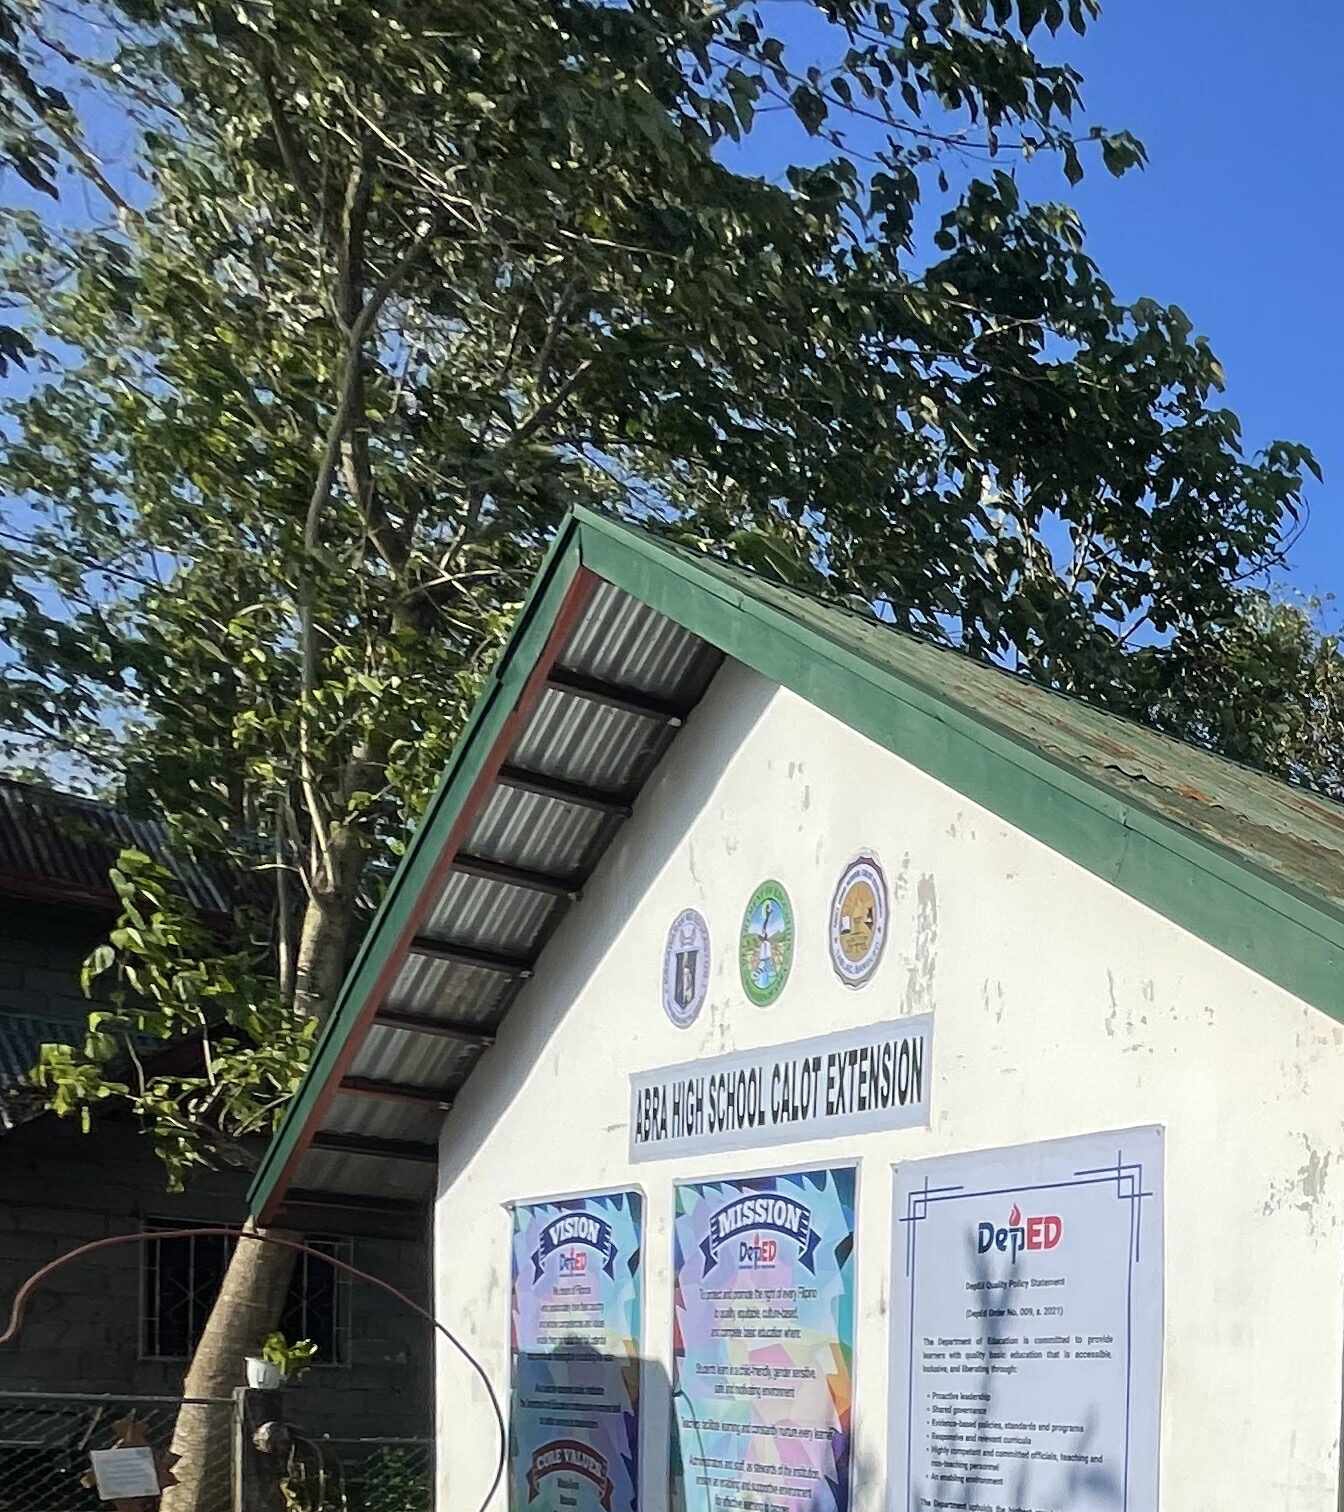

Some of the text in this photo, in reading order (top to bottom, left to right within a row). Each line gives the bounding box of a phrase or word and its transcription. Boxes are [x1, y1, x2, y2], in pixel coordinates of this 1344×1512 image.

[635, 1036, 924, 1144] ABRA HIGH SCHOOL CALOT EXTENSION
[549, 1216, 601, 1246] VISION
[718, 1199, 802, 1237] MISSION
[978, 1212, 1063, 1264] DepED
[1008, 1279, 1029, 1288] Policy
[1031, 1278, 1065, 1287] Statement
